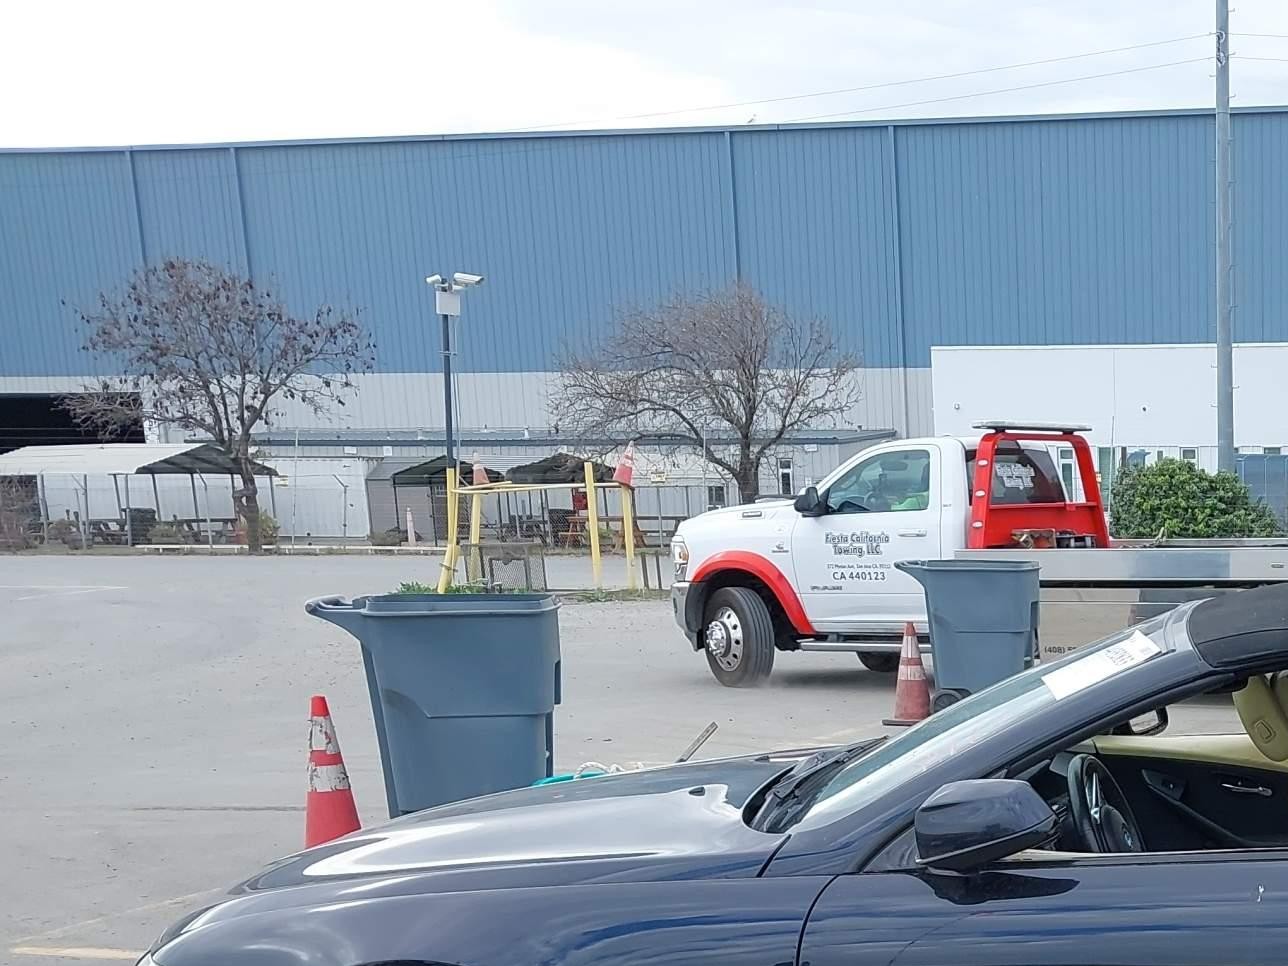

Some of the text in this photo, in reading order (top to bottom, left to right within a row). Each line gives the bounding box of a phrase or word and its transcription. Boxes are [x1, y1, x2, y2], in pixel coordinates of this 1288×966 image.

[825, 531, 890, 544] Fiesta California
[833, 543, 865, 558] Towing,
[832, 571, 886, 581] CA 440123
[1044, 646, 1066, 654] (408)
